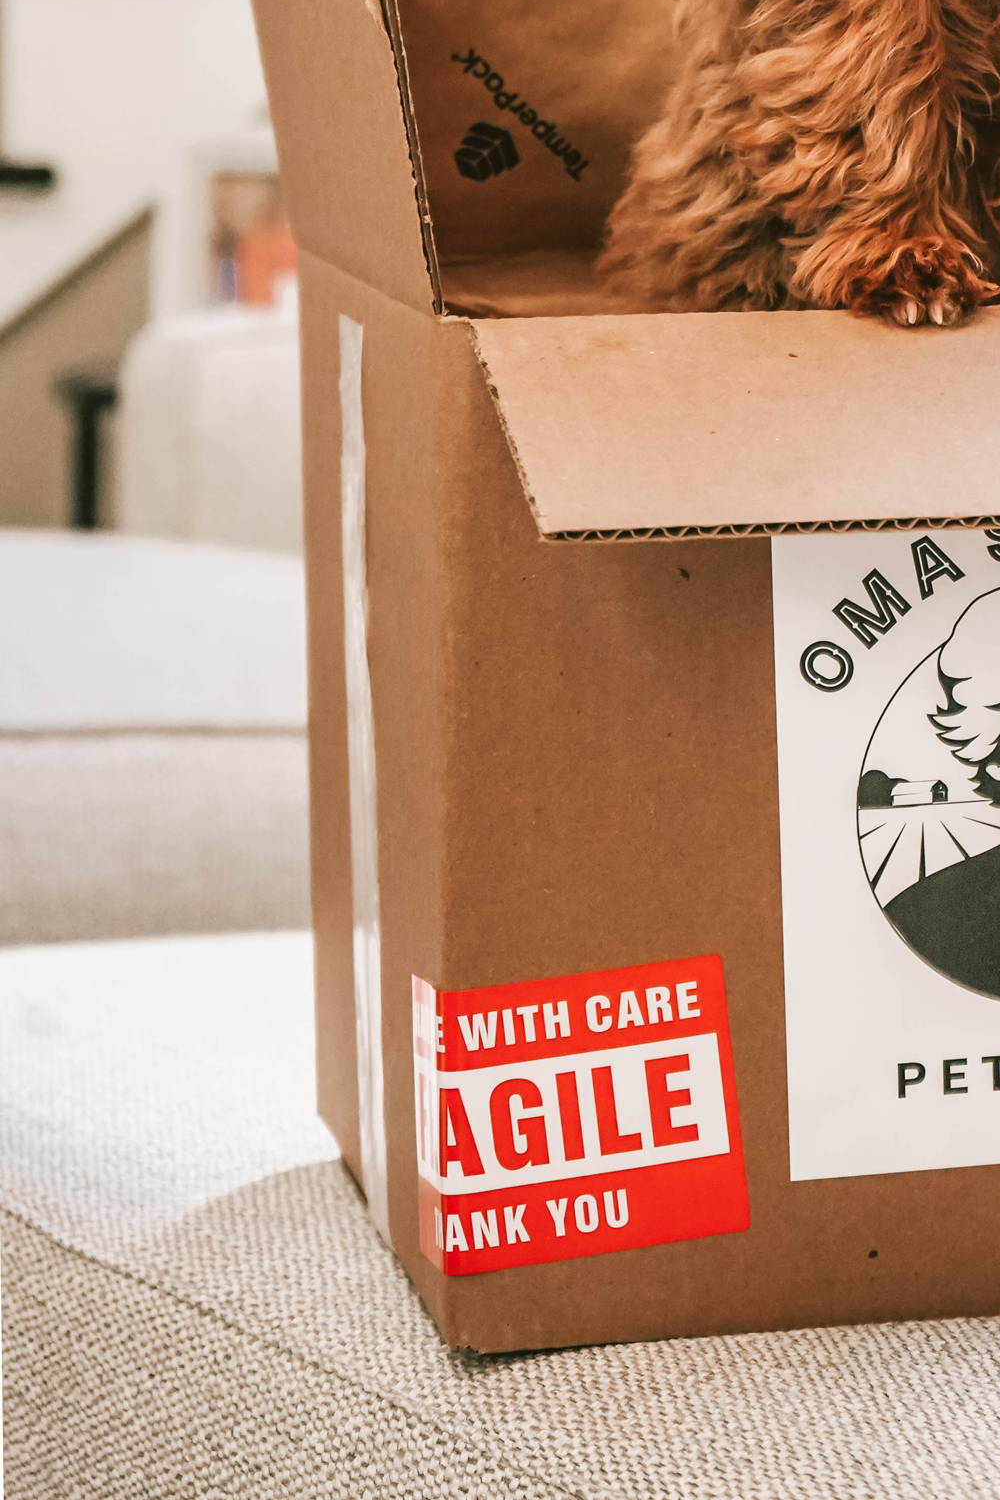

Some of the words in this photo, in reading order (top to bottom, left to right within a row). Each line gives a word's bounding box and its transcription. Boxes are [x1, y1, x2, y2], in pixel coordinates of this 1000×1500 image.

[452, 48, 590, 182] TemperPack
[457, 1000, 571, 1052] WITH
[585, 980, 701, 1033] CARE
[545, 1188, 630, 1237] YOU
